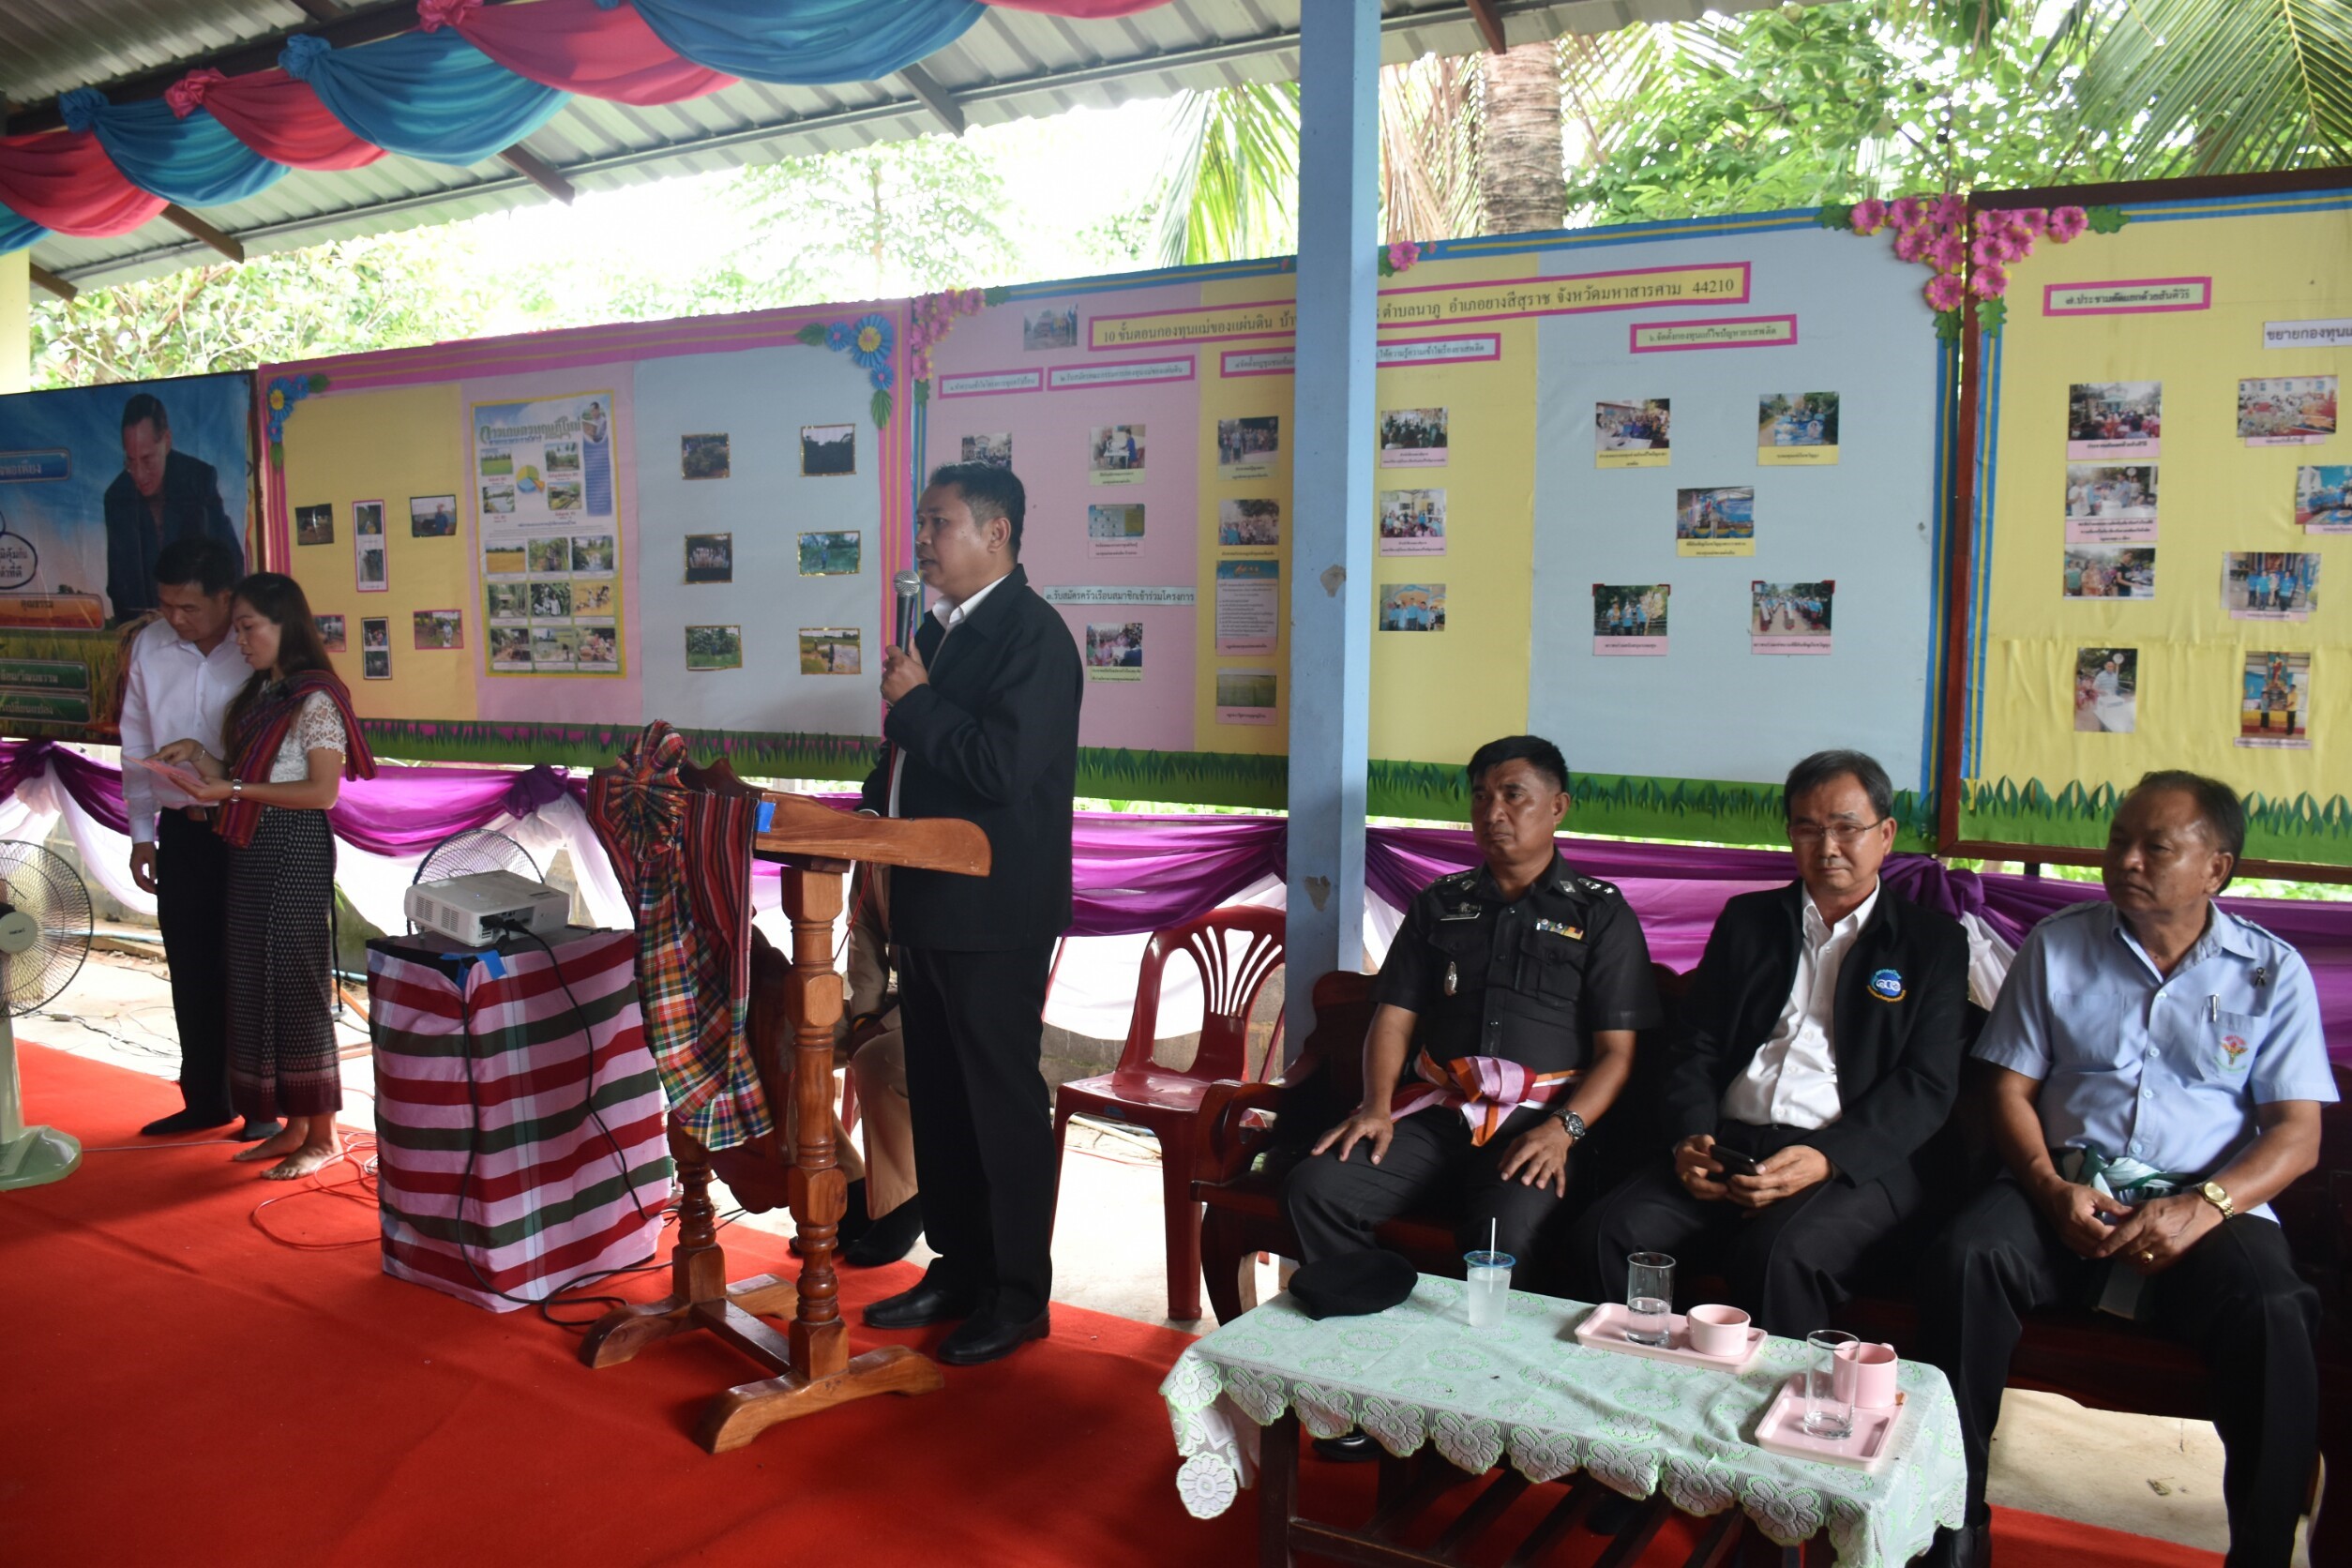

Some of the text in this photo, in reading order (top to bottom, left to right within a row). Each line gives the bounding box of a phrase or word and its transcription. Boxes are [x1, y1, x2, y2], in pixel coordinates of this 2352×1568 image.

[1382, 302, 1440, 320] ตำบลนาภู
[1449, 291, 1551, 313] อำเภอยางสีสุราช
[1557, 283, 1681, 304] จังหวัดมหาสารคาม
[1692, 279, 1734, 294] 44210
[1104, 331, 1115, 342] 10
[1118, 314, 1273, 341] ขั้นตอนกองทุนแม่ของแผ่นดิน
